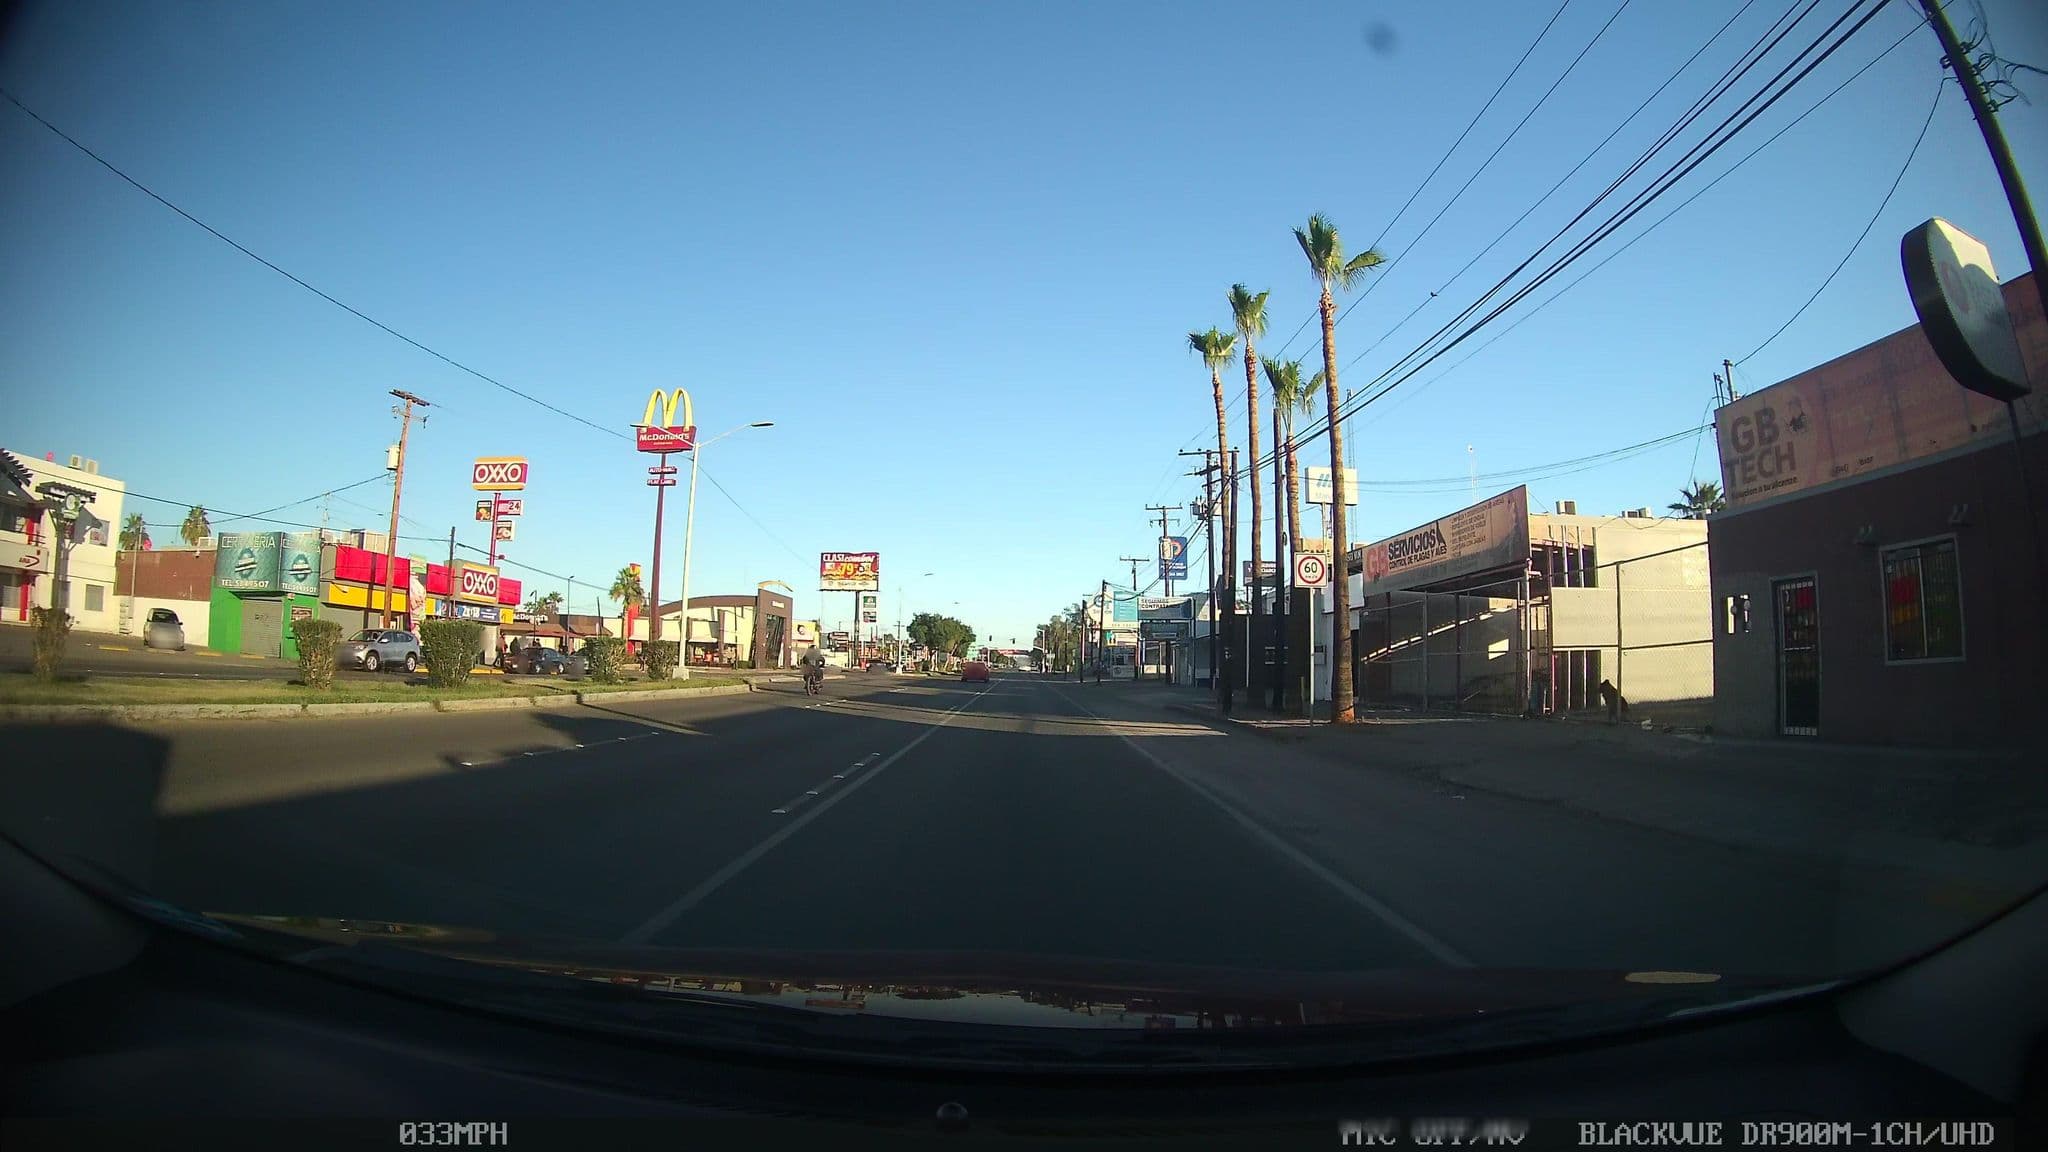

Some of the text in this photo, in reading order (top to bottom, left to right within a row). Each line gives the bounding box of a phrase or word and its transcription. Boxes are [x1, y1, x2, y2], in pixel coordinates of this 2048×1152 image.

[640, 433, 690, 442] McDonald's
[1731, 407, 1780, 453] GB
[475, 464, 522, 483] OXXO
[1725, 442, 1797, 492] TECH
[508, 502, 520, 510] 24
[1366, 545, 1389, 577] GB
[1388, 529, 1436, 560] SERVICIOS
[1389, 555, 1407, 570] CONTROL
[1407, 554, 1414, 565] DE
[1414, 549, 1431, 563] PLAGAS
[1304, 562, 1318, 574] 60
[464, 571, 496, 595] OXXO
